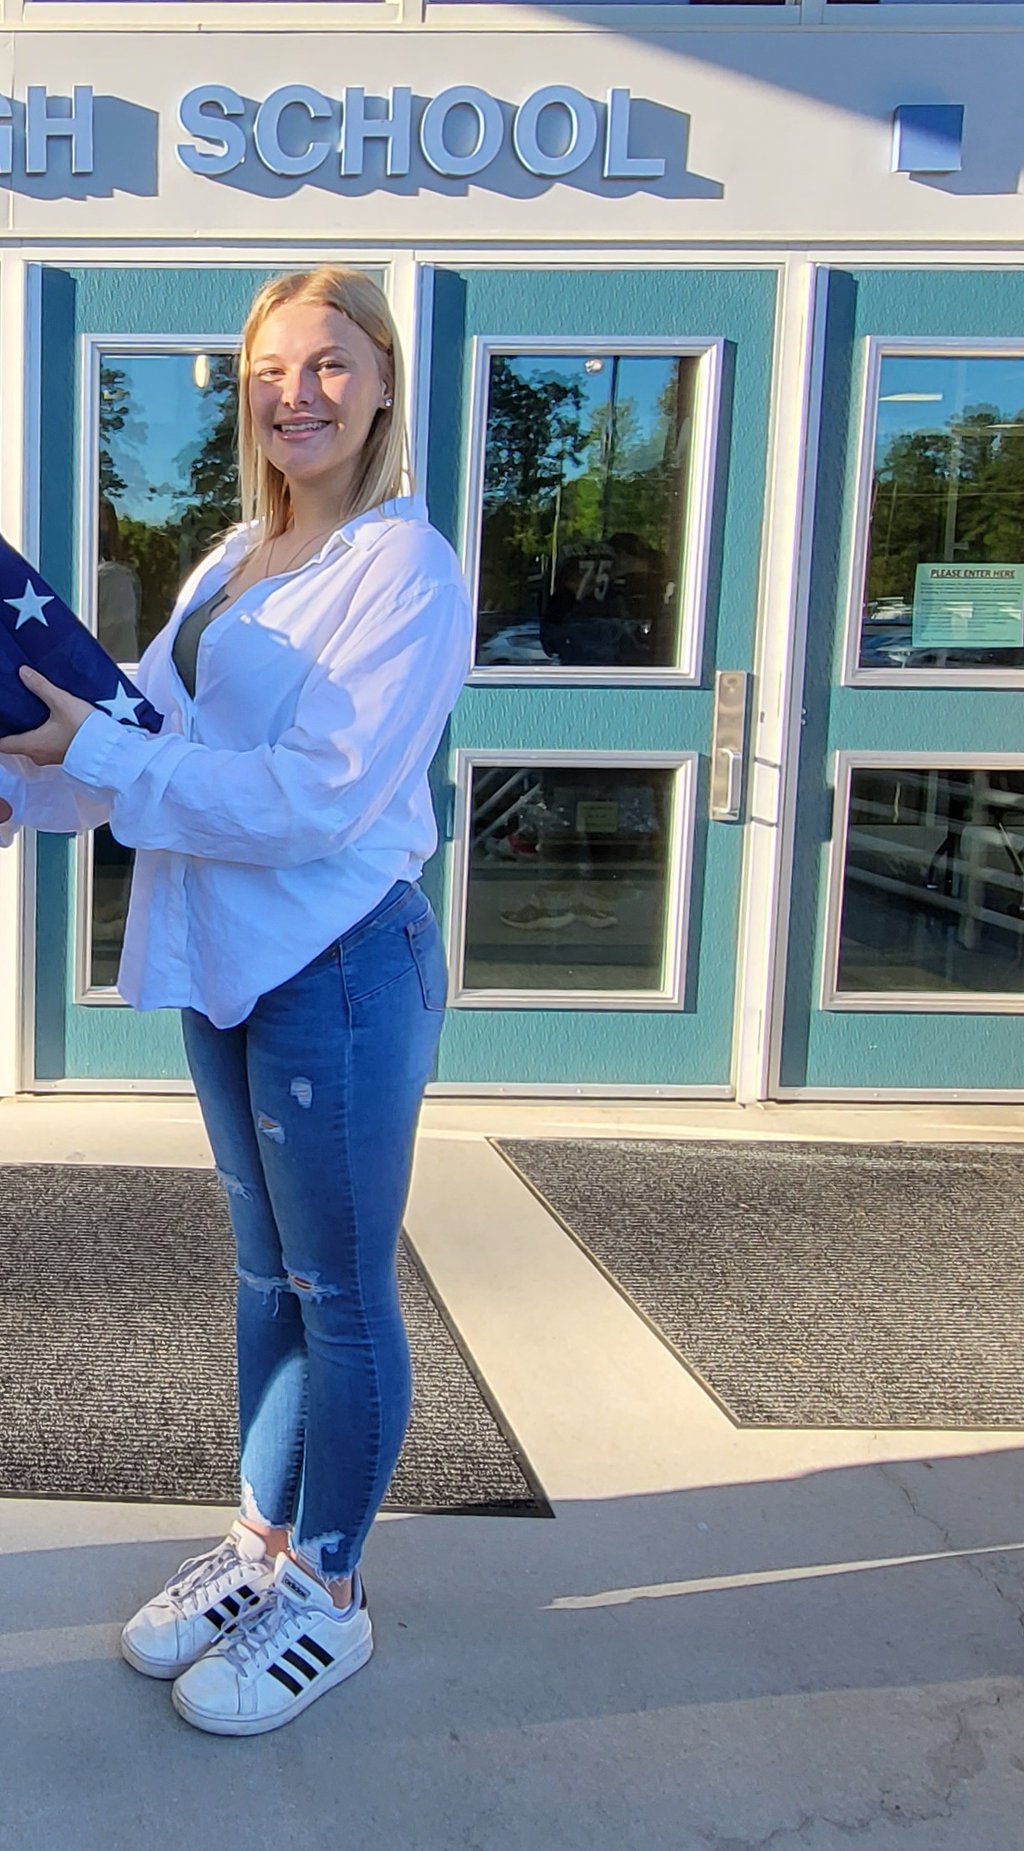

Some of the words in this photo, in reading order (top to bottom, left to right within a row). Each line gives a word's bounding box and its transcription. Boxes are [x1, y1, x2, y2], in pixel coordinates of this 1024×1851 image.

[176, 83, 667, 179] SCHOOL
[930, 569, 962, 578] PLEASE
[964, 569, 991, 578] ENTER
[993, 570, 1015, 578] HERE
